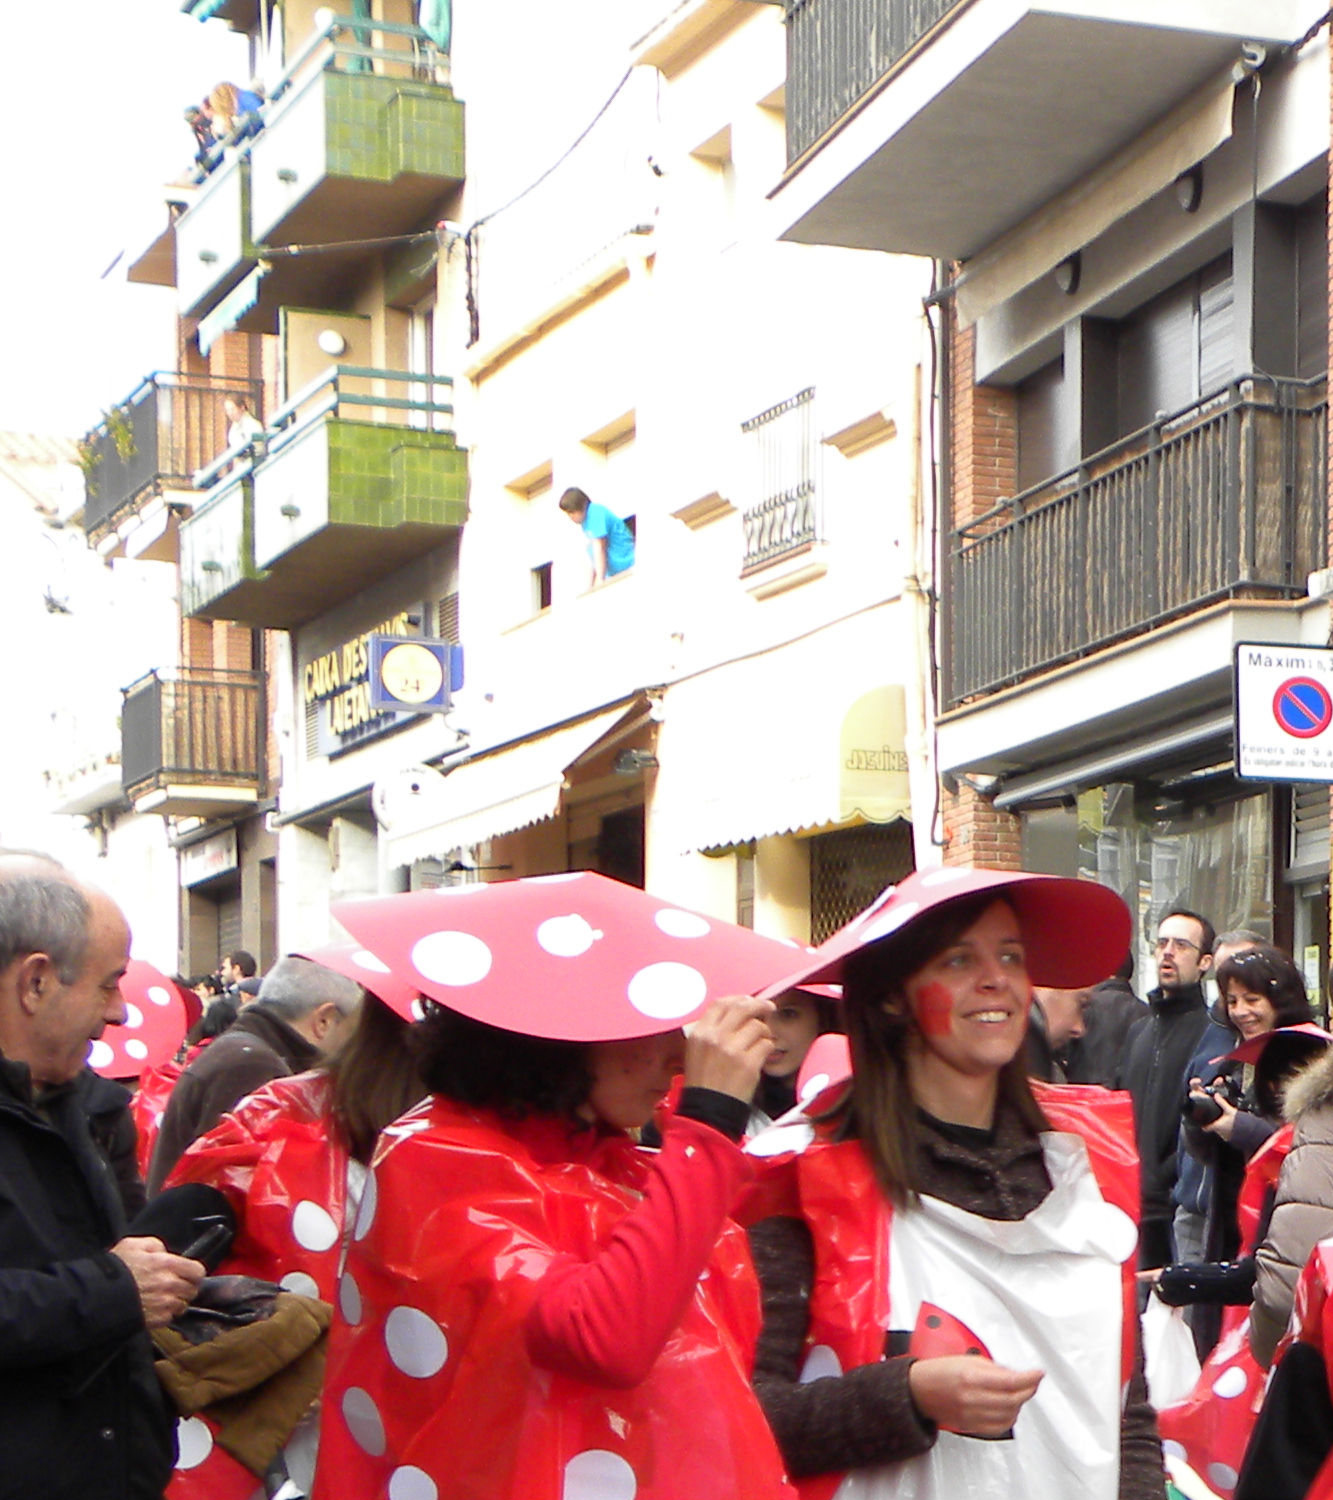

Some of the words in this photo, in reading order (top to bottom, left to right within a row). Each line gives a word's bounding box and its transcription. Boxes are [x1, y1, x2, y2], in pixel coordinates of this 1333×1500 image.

[304, 651, 341, 703] CAIXA
[1242, 743, 1285, 755] Feiners
[1293, 746, 1306, 756] de
[1313, 747, 1320, 757] 9
[1326, 749, 1333, 757] a
